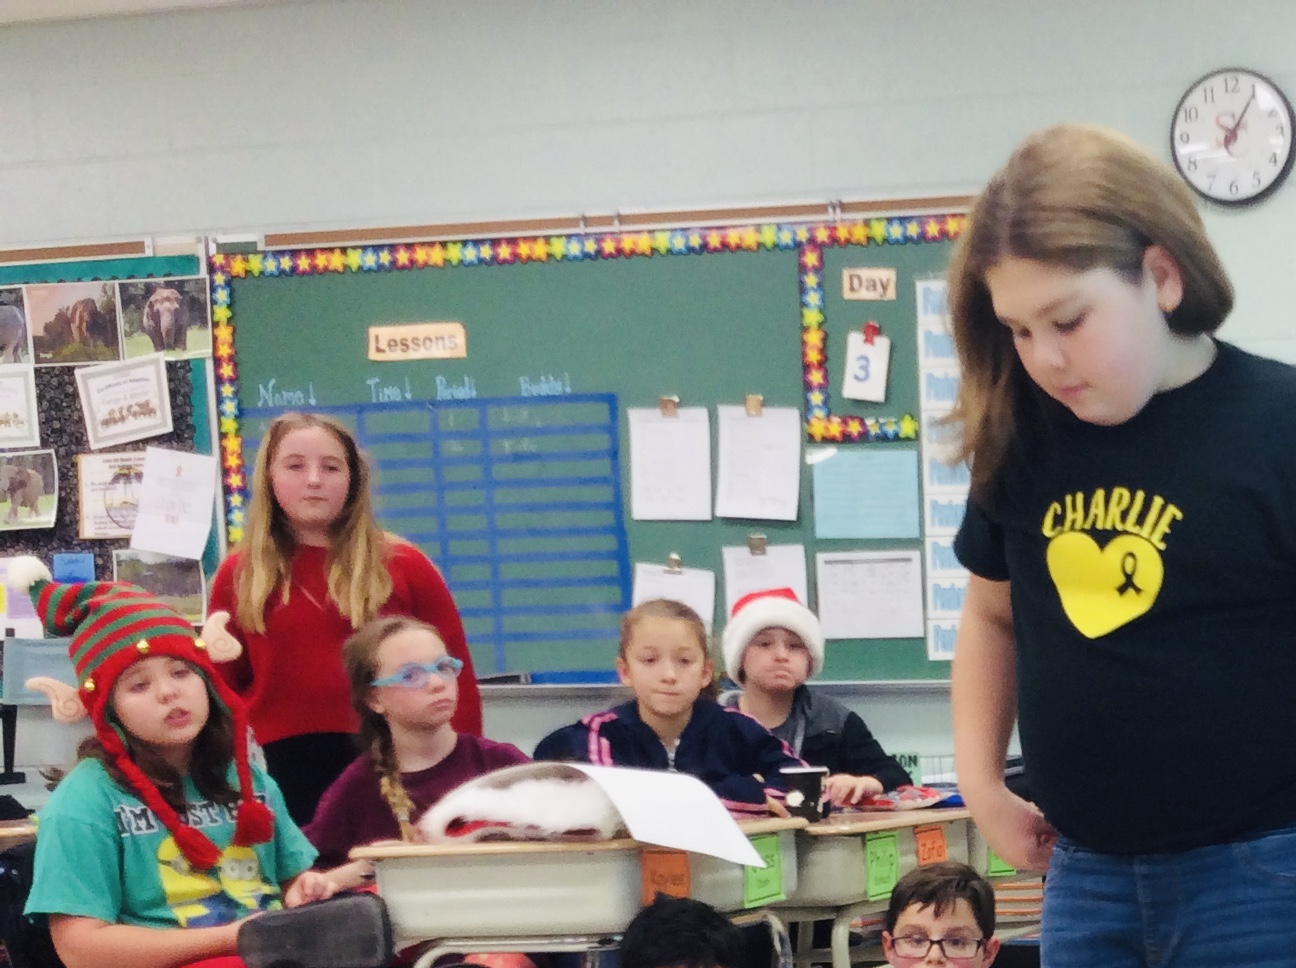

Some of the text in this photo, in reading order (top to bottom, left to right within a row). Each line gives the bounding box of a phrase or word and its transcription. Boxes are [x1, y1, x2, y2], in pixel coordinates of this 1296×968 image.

[1224, 78, 1240, 94] 12
[1203, 87, 1215, 104] 11
[1183, 106, 1199, 124] 10
[1180, 131, 1190, 144] 9
[1187, 156, 1198, 172] 8
[1268, 152, 1278, 167] 4
[1229, 180, 1239, 196] 6
[848, 273, 890, 298] Day
[373, 333, 459, 356] Lessons
[853, 355, 871, 382] 3
[1041, 486, 1184, 551] CHARLIE
